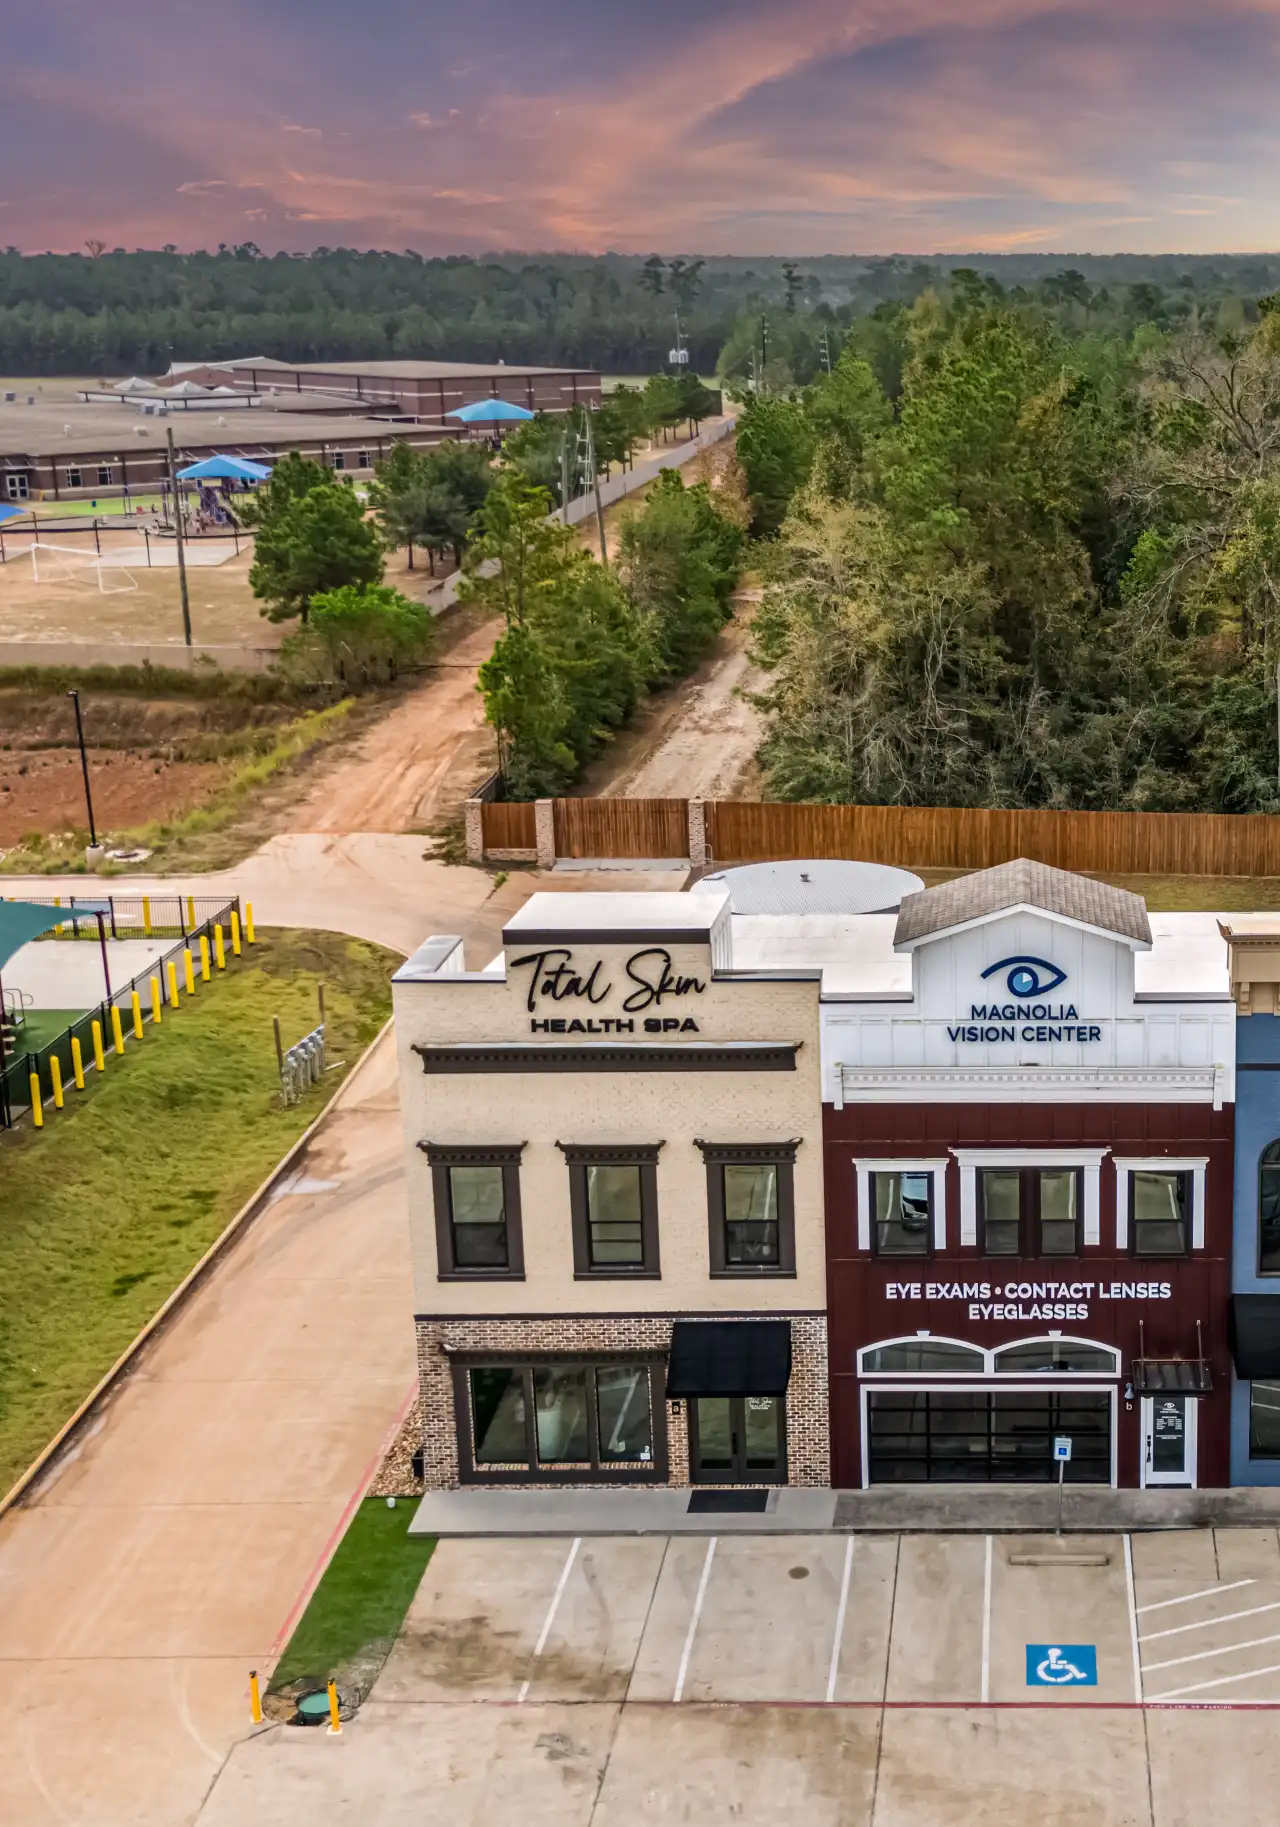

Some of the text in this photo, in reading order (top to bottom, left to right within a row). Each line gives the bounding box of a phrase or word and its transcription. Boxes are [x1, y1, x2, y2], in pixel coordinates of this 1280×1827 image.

[510, 948, 706, 1012] Total Skin
[971, 1004, 1079, 1020] MAGNOLIA
[530, 1018, 700, 1033] HEALTH SPA
[947, 1026, 1101, 1042] VISION CENTER
[885, 1283, 1172, 1299] EYE EXAMS CONTACT LENSES
[968, 1304, 1089, 1320] EYEGLASSES
[1126, 1402, 1133, 1410] b
